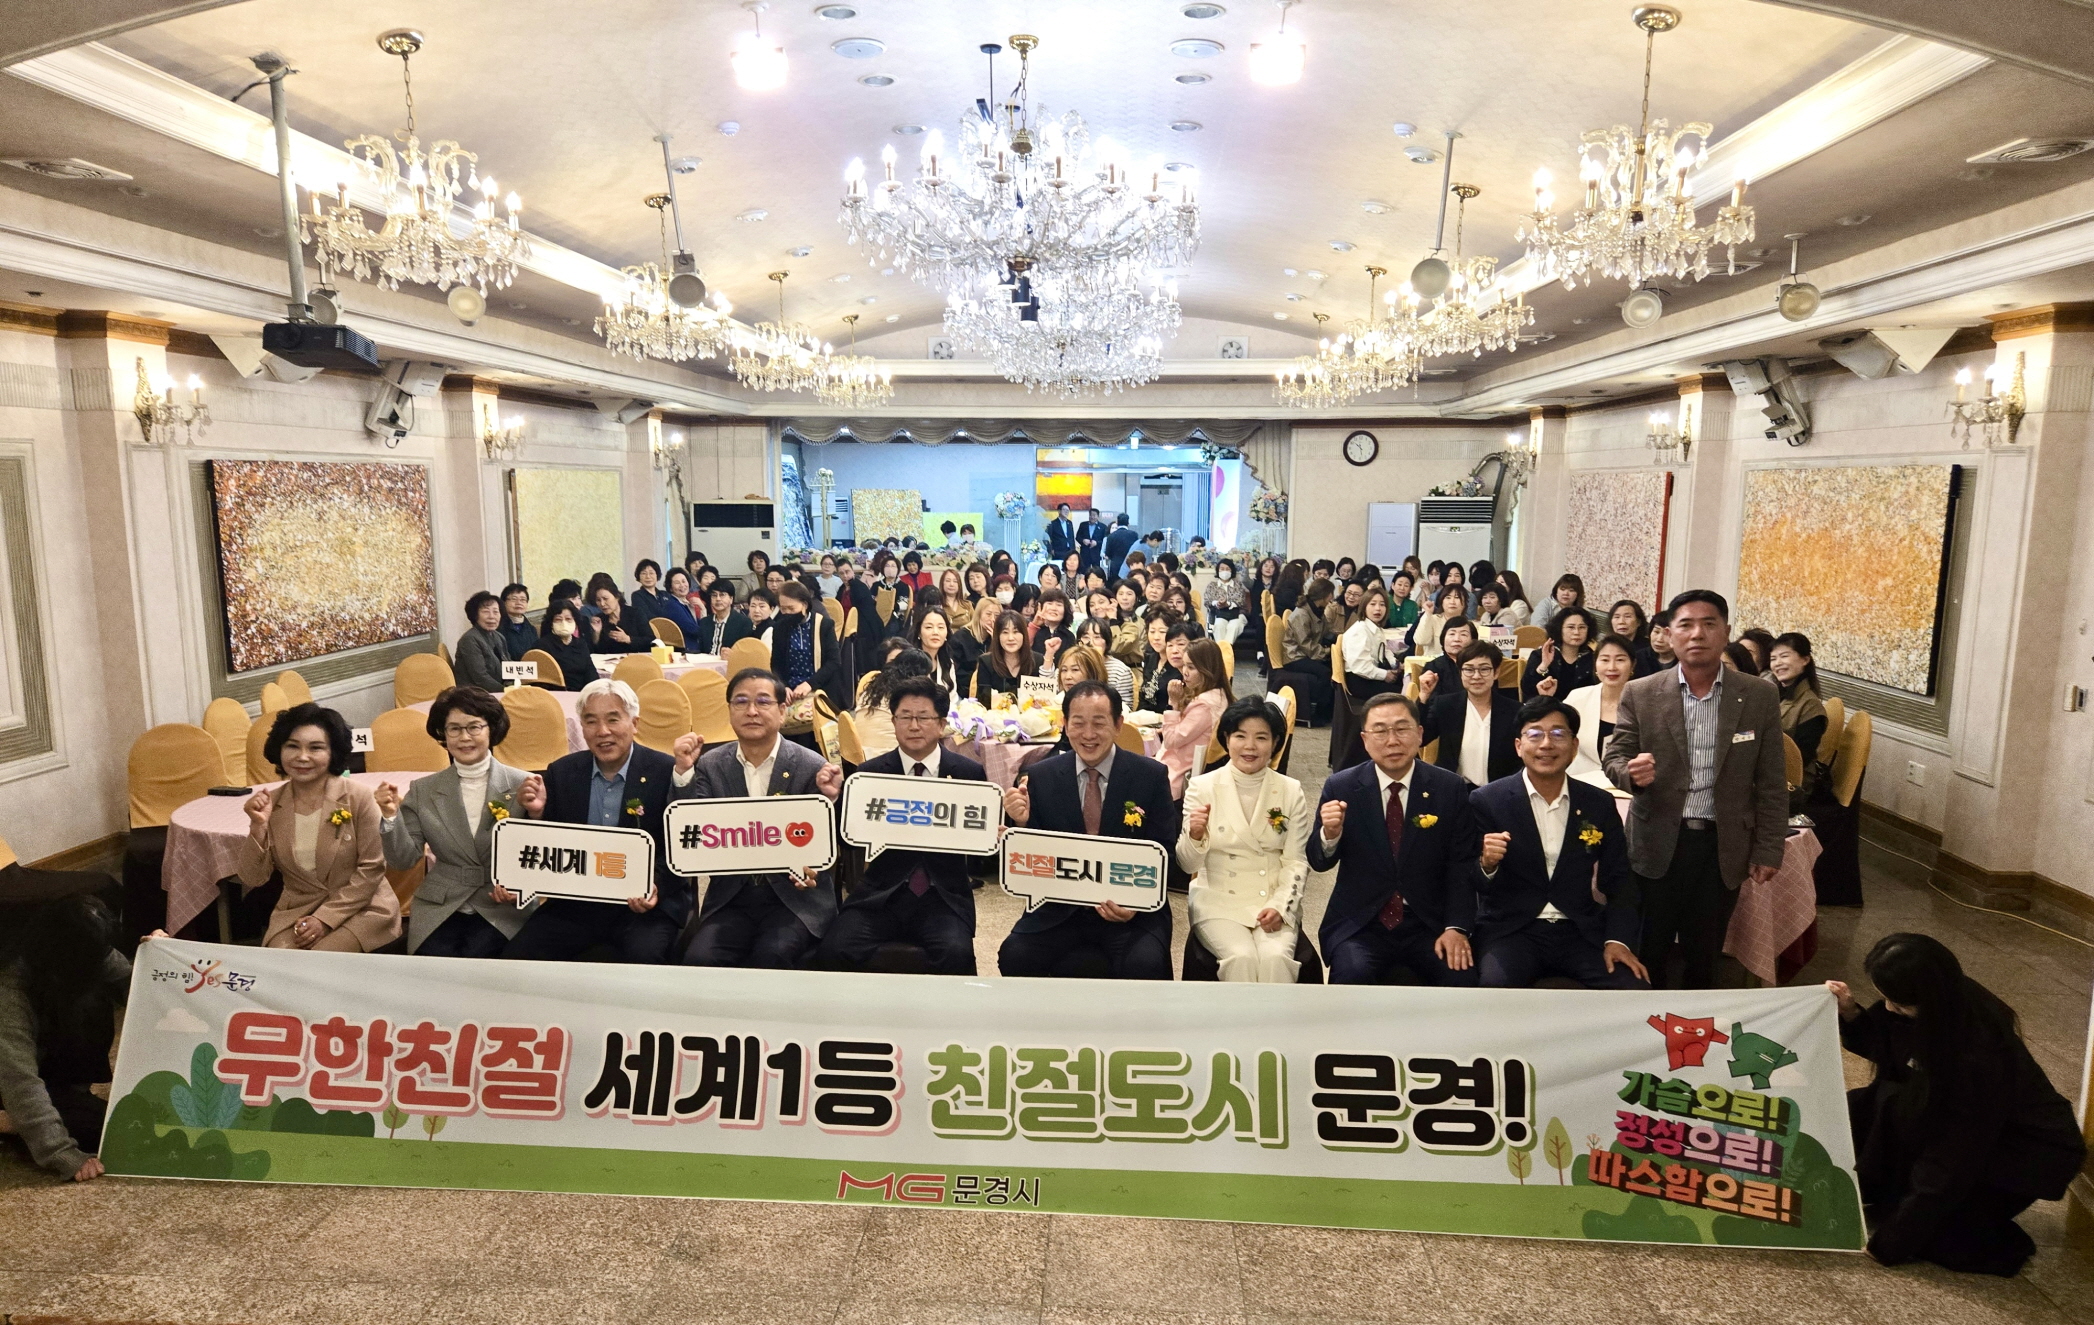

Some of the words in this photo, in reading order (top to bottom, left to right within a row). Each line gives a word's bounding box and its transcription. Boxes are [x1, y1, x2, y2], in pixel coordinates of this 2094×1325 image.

[505, 665, 534, 676] 내빈석
[1023, 680, 1054, 692] 수상자석
[865, 798, 957, 828] #긍정의
[963, 804, 987, 831] 힘
[679, 820, 782, 850] #Smile
[518, 844, 588, 877] #세계
[593, 850, 627, 879] 1등
[1009, 851, 1103, 884] 친절도시
[1108, 861, 1158, 889] 문경
[151, 969, 179, 982] 긍정의
[181, 972, 194, 983] 힘!
[216, 1011, 567, 1115] 무한친절
[583, 1030, 899, 1132] 세계1등
[925, 1042, 1285, 1146] 친절도시
[1310, 1052, 1530, 1148] 문경!
[1616, 1069, 1781, 1131] 가슴으로!
[1613, 1109, 1776, 1174] 정성으로!
[836, 1170, 946, 1202] MG
[951, 1175, 1040, 1206] 문경시
[1588, 1148, 1793, 1223] 따스함으로!
